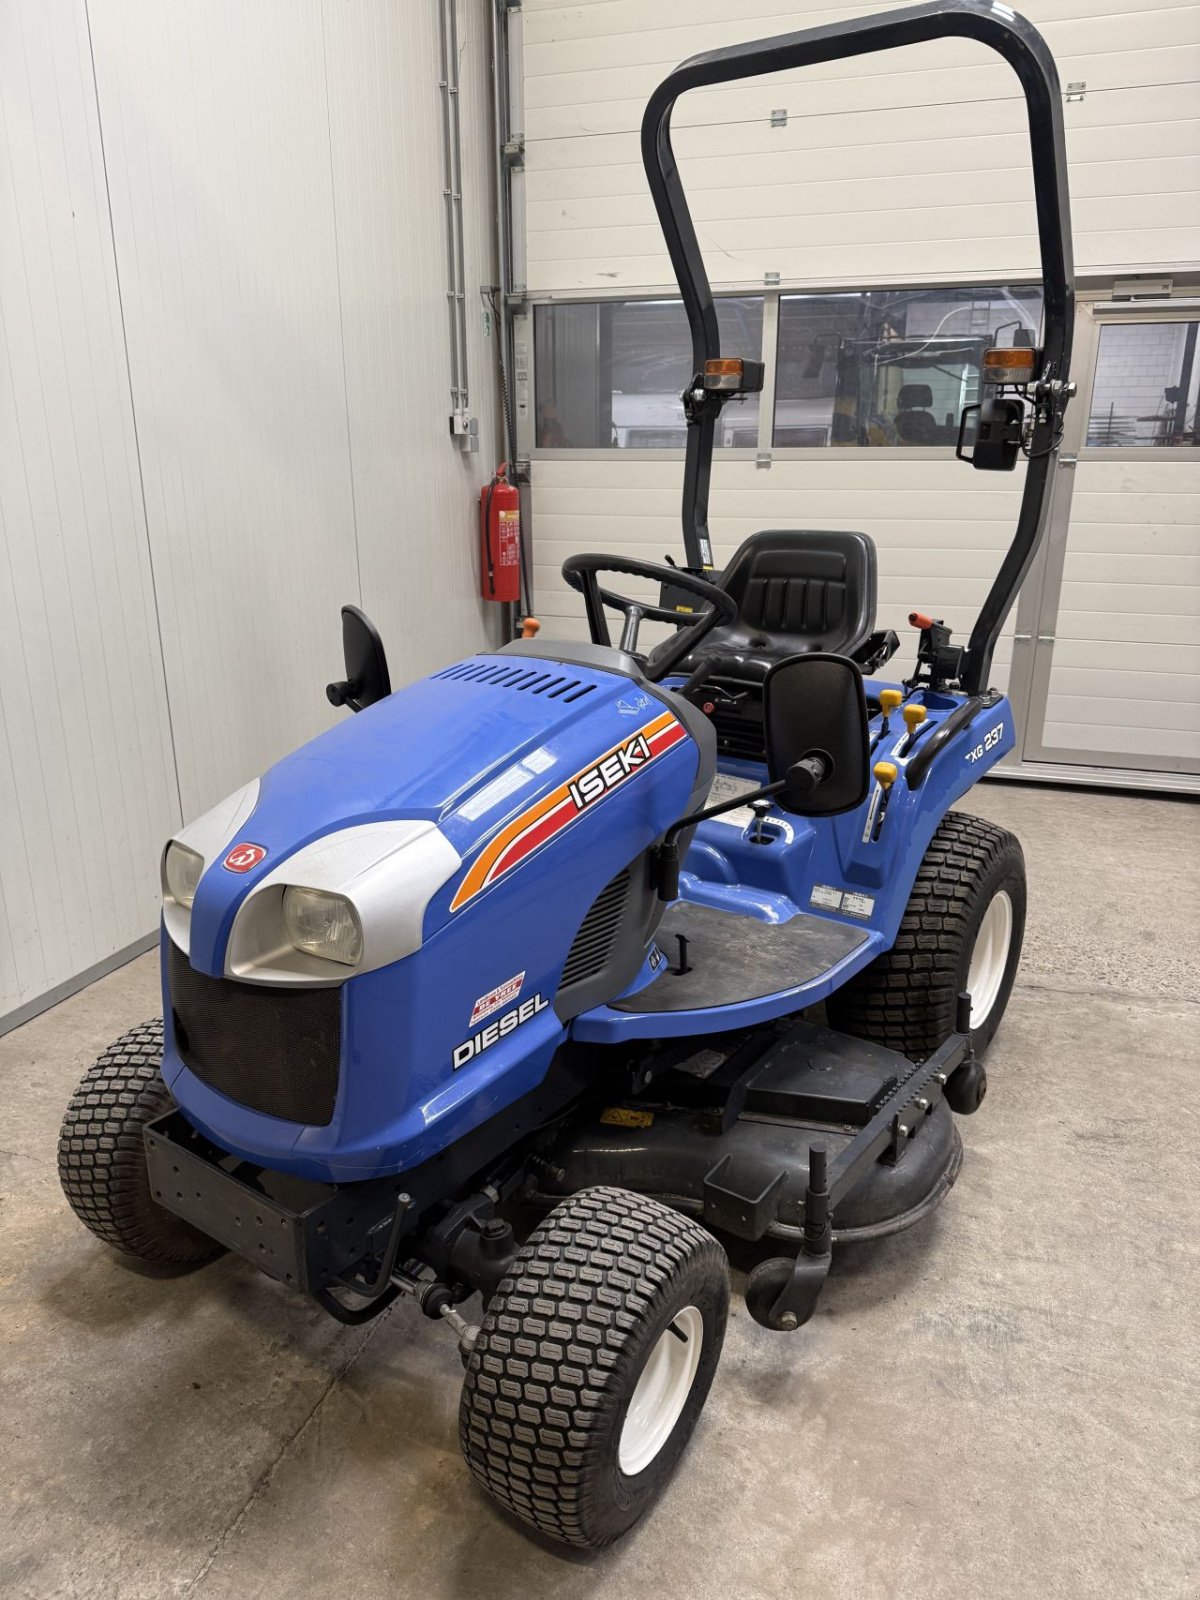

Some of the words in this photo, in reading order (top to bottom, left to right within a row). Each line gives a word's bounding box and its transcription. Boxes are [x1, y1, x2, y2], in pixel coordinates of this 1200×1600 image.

[569, 734, 651, 810] ISEKI
[984, 722, 1003, 751] 237
[453, 993, 549, 1070] DIESEL
